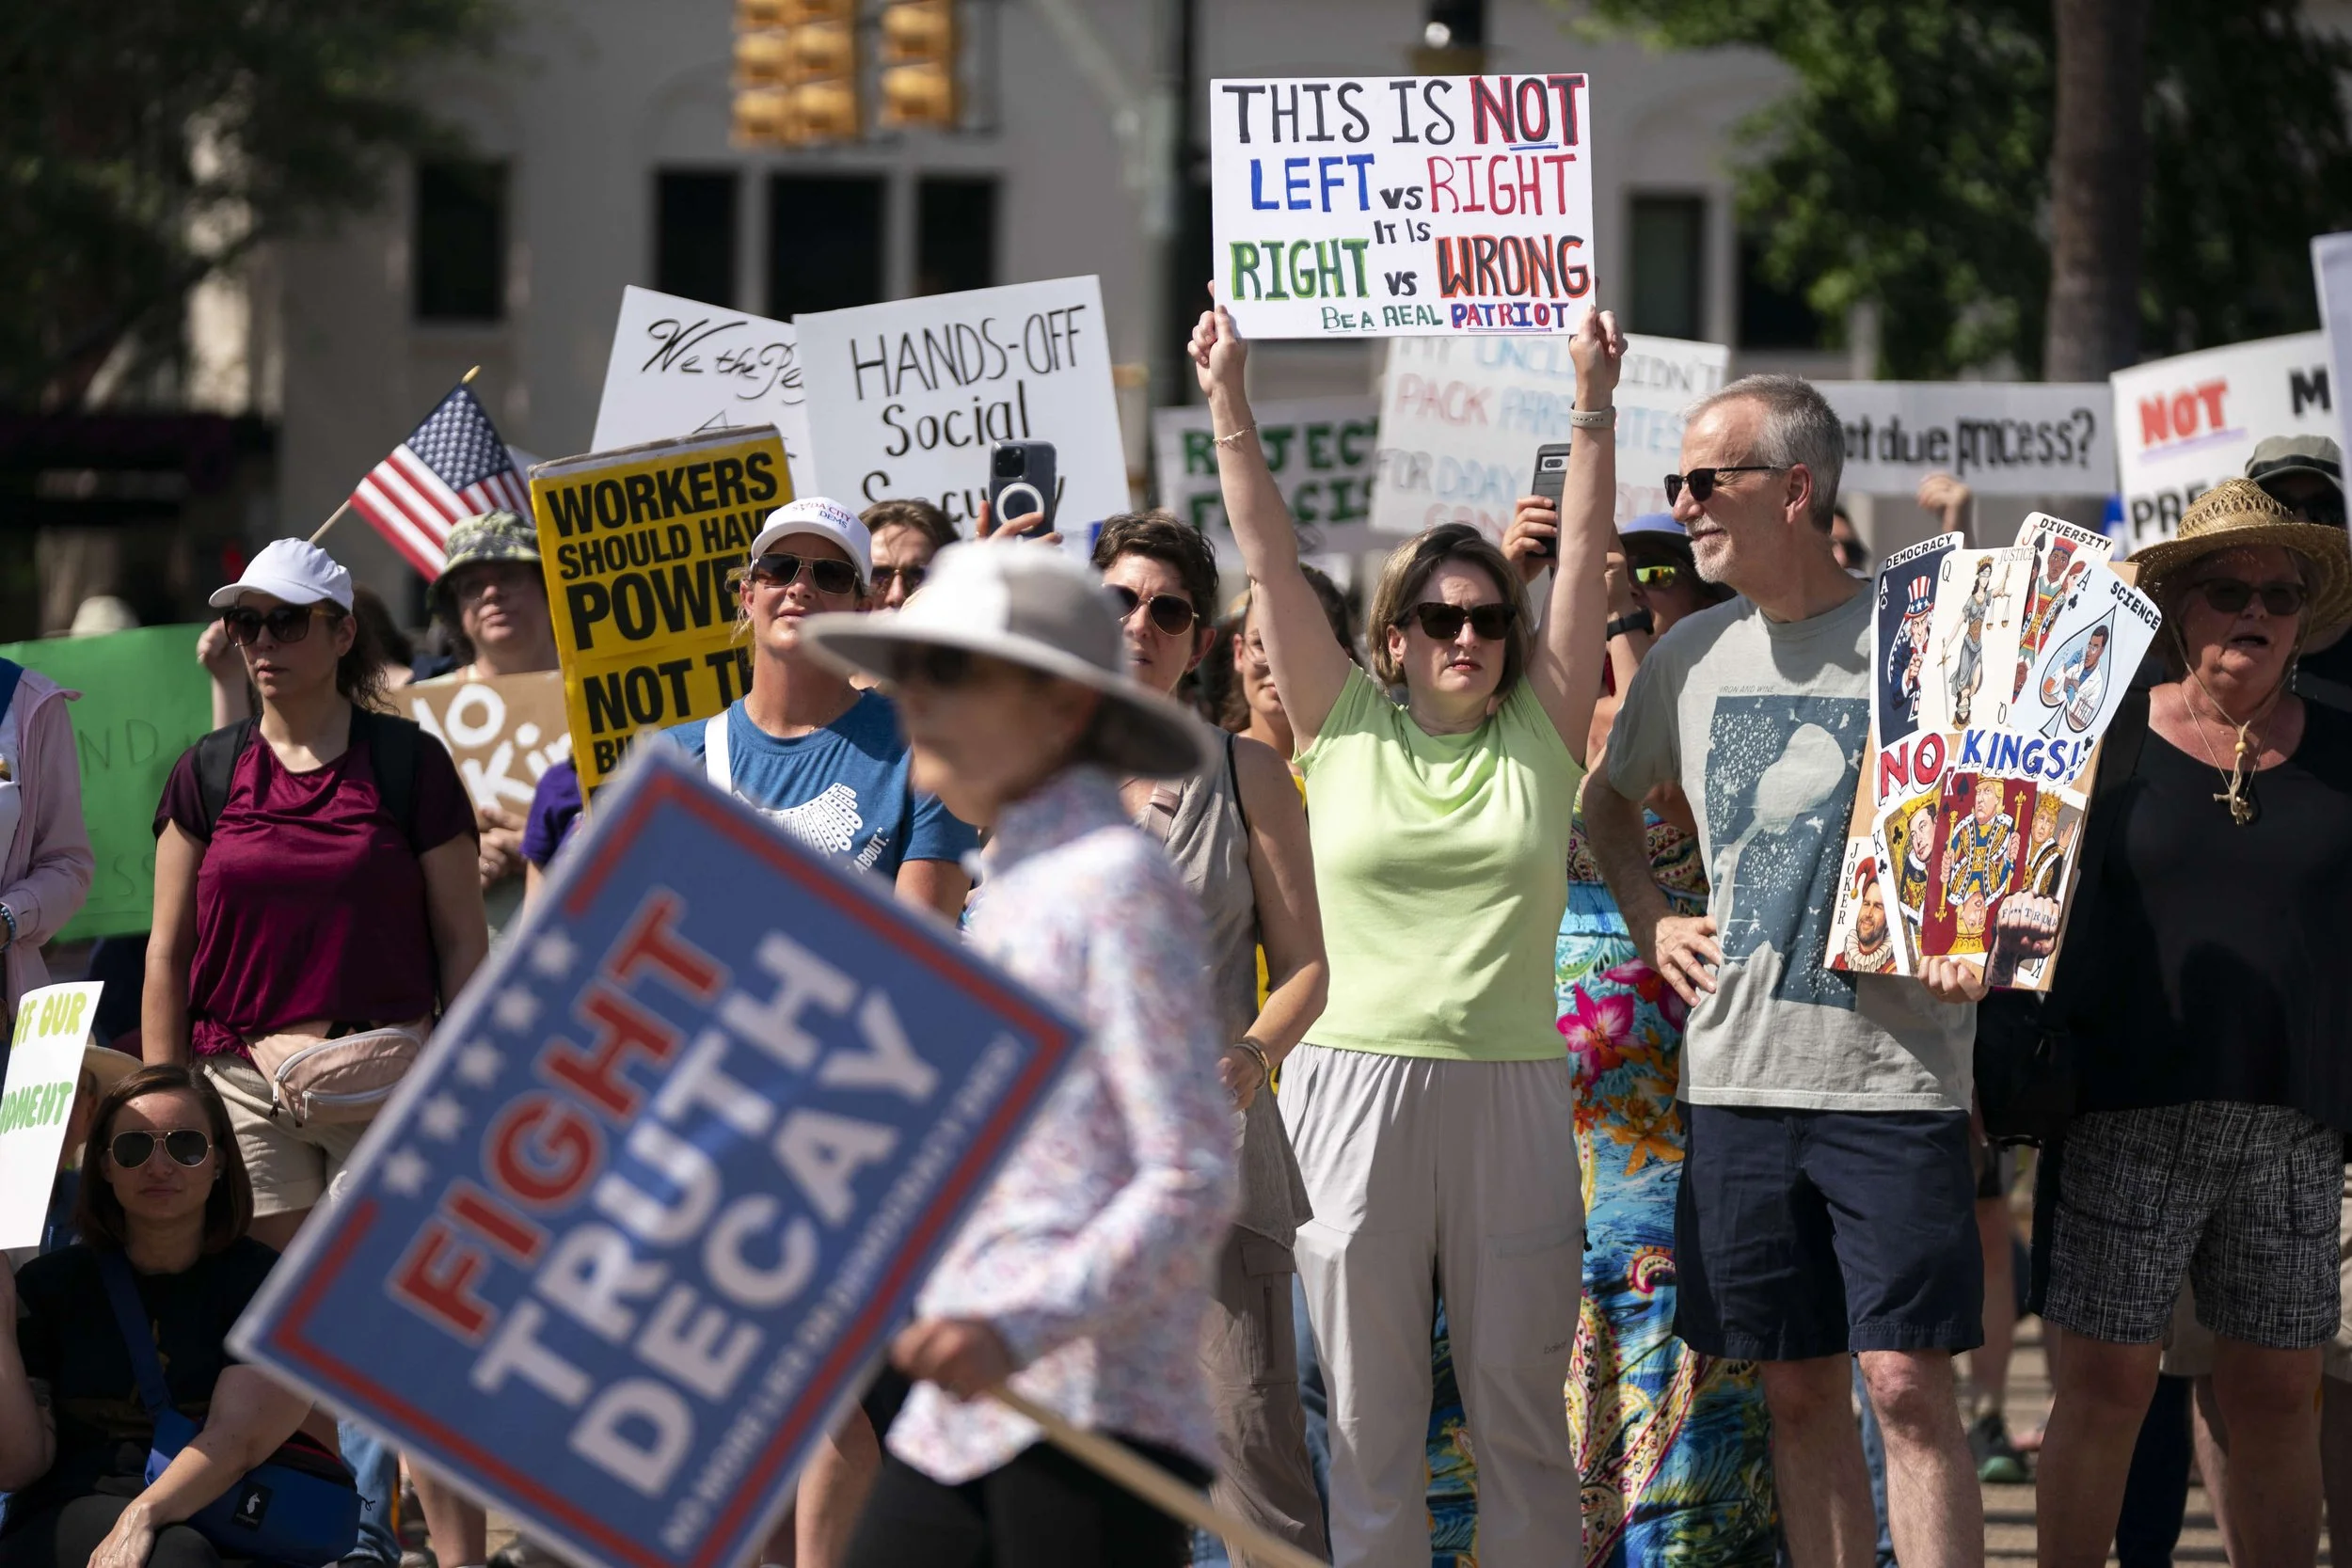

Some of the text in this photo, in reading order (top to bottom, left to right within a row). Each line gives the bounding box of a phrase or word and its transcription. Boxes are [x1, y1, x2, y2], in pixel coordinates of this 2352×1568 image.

[1222, 74, 1584, 146] THIS IS NOT
[1250, 152, 1578, 215] LEFT vs RIGHT
[1374, 219, 1398, 245] IT
[1229, 237, 1371, 301] RIGHT
[1435, 233, 1591, 299] WRONG
[1360, 310, 1375, 329] A
[1383, 304, 1444, 327] REAL
[1451, 301, 1569, 329] PATRIOT
[642, 317, 805, 401] We the Pe
[850, 304, 1087, 401] HANDS-OFF
[882, 378, 1030, 457] Social
[1395, 372, 1491, 427] PACK
[2138, 379, 2230, 448] NOT
[1879, 414, 1950, 464] due
[1954, 408, 2096, 477] process?
[546, 451, 778, 538] WORKERS
[819, 510, 848, 529] DEMS
[828, 506, 850, 522] CITY
[557, 523, 691, 580] SHOULD
[1885, 533, 1953, 570] DEMOCRACY
[1997, 547, 2034, 565] JUSTICE
[2022, 524, 2038, 546] J
[2040, 517, 2112, 551] DIVERSITY
[565, 553, 755, 651] POWE
[2077, 568, 2093, 593] A
[2110, 580, 2162, 631] SCIENCE
[582, 658, 693, 735] NOT
[1878, 729, 2081, 808] NO KINGS!
[1944, 769, 1956, 798] K
[1836, 843, 1861, 926] JOKER
[38, 991, 87, 1037] OUR
[393, 893, 725, 1337] FIGHT
[470, 929, 863, 1404] TRUTH
[568, 988, 939, 1497] DECAY
